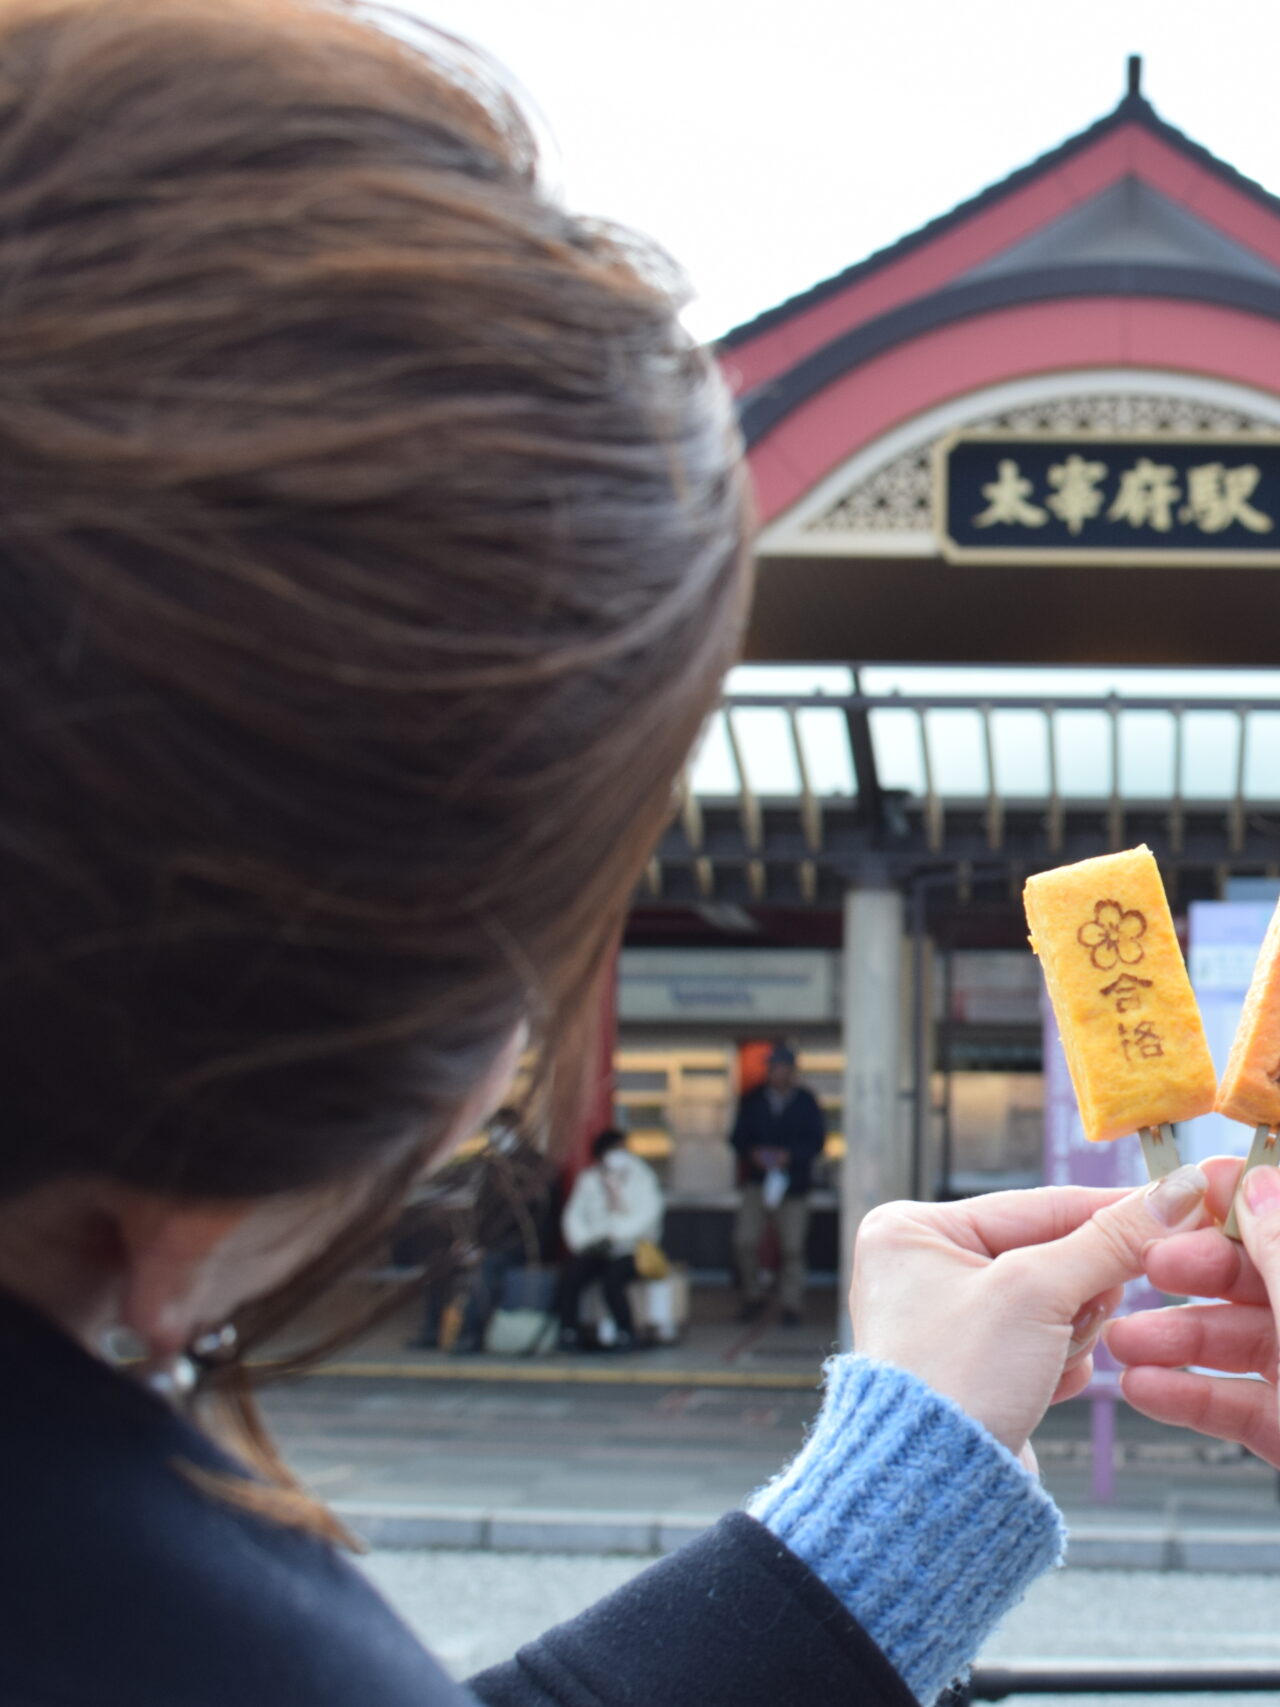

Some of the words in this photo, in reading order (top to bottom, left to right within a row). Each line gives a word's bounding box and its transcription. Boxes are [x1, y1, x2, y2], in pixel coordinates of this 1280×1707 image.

[972, 453, 1274, 536] 太宰府駅
[1100, 972, 1165, 1063] 合格
